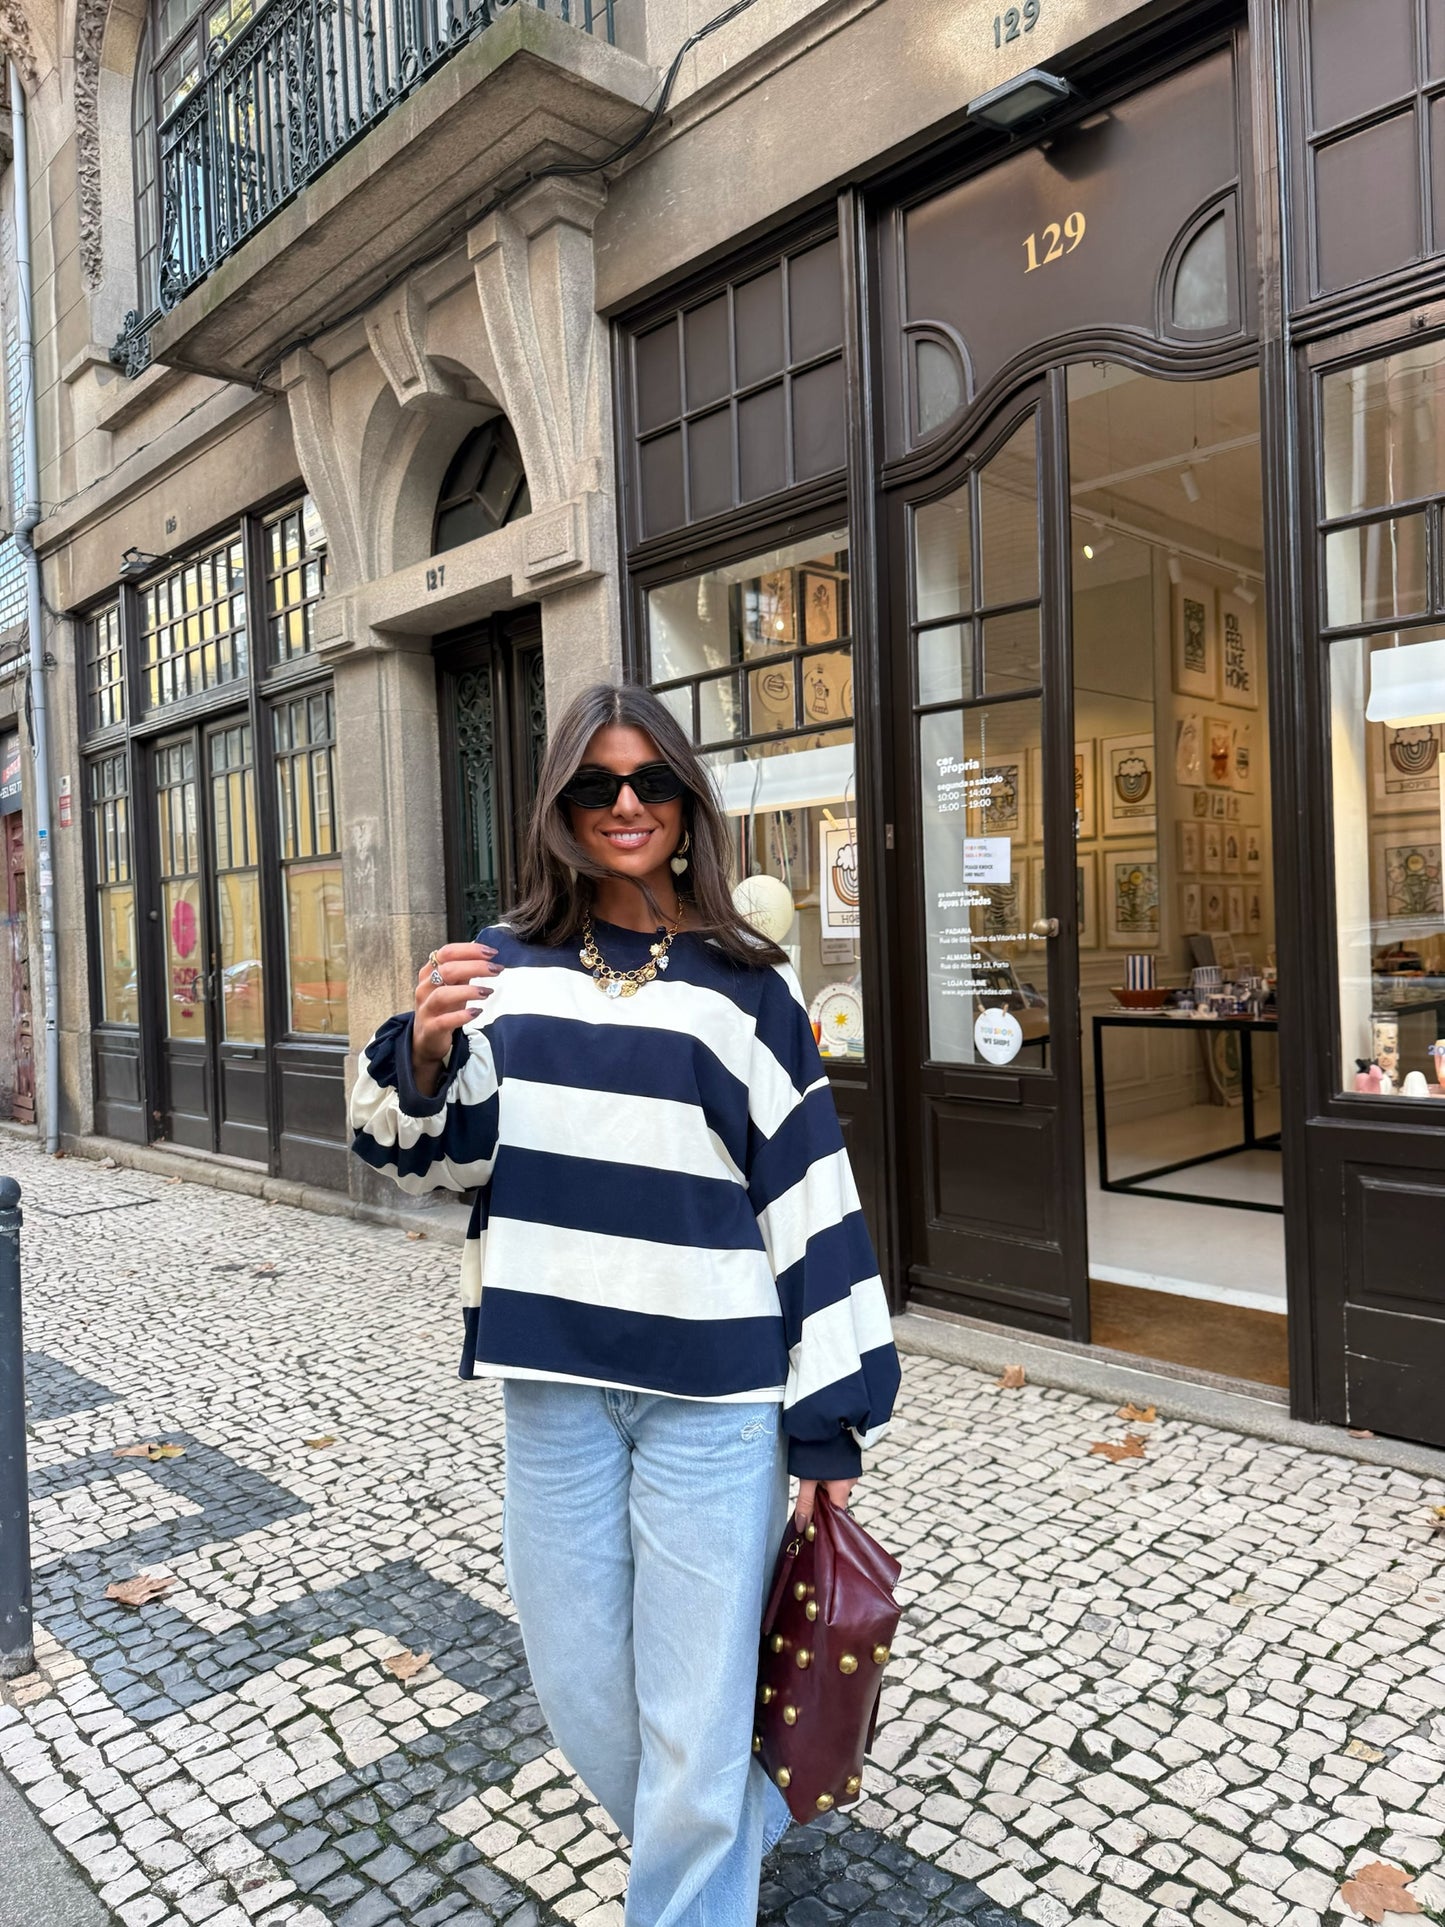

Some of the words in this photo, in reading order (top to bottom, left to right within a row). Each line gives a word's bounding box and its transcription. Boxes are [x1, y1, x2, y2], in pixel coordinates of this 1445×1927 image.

[994, 0, 1040, 48] 129
[1022, 211, 1086, 273] 129
[426, 565, 445, 592] 127
[1225, 630, 1246, 652] FEEL
[1225, 650, 1245, 670] LIKE
[1225, 667, 1250, 692] HOME
[937, 791, 960, 802] 10:00
[969, 787, 992, 797] 14:00
[938, 802, 960, 813] 15:00
[969, 798, 992, 809] 19:00
[959, 896, 991, 907] furtadas
[971, 935, 988, 943] Bento
[946, 953, 972, 961] ALMADA
[964, 979, 987, 987] ONLINE
